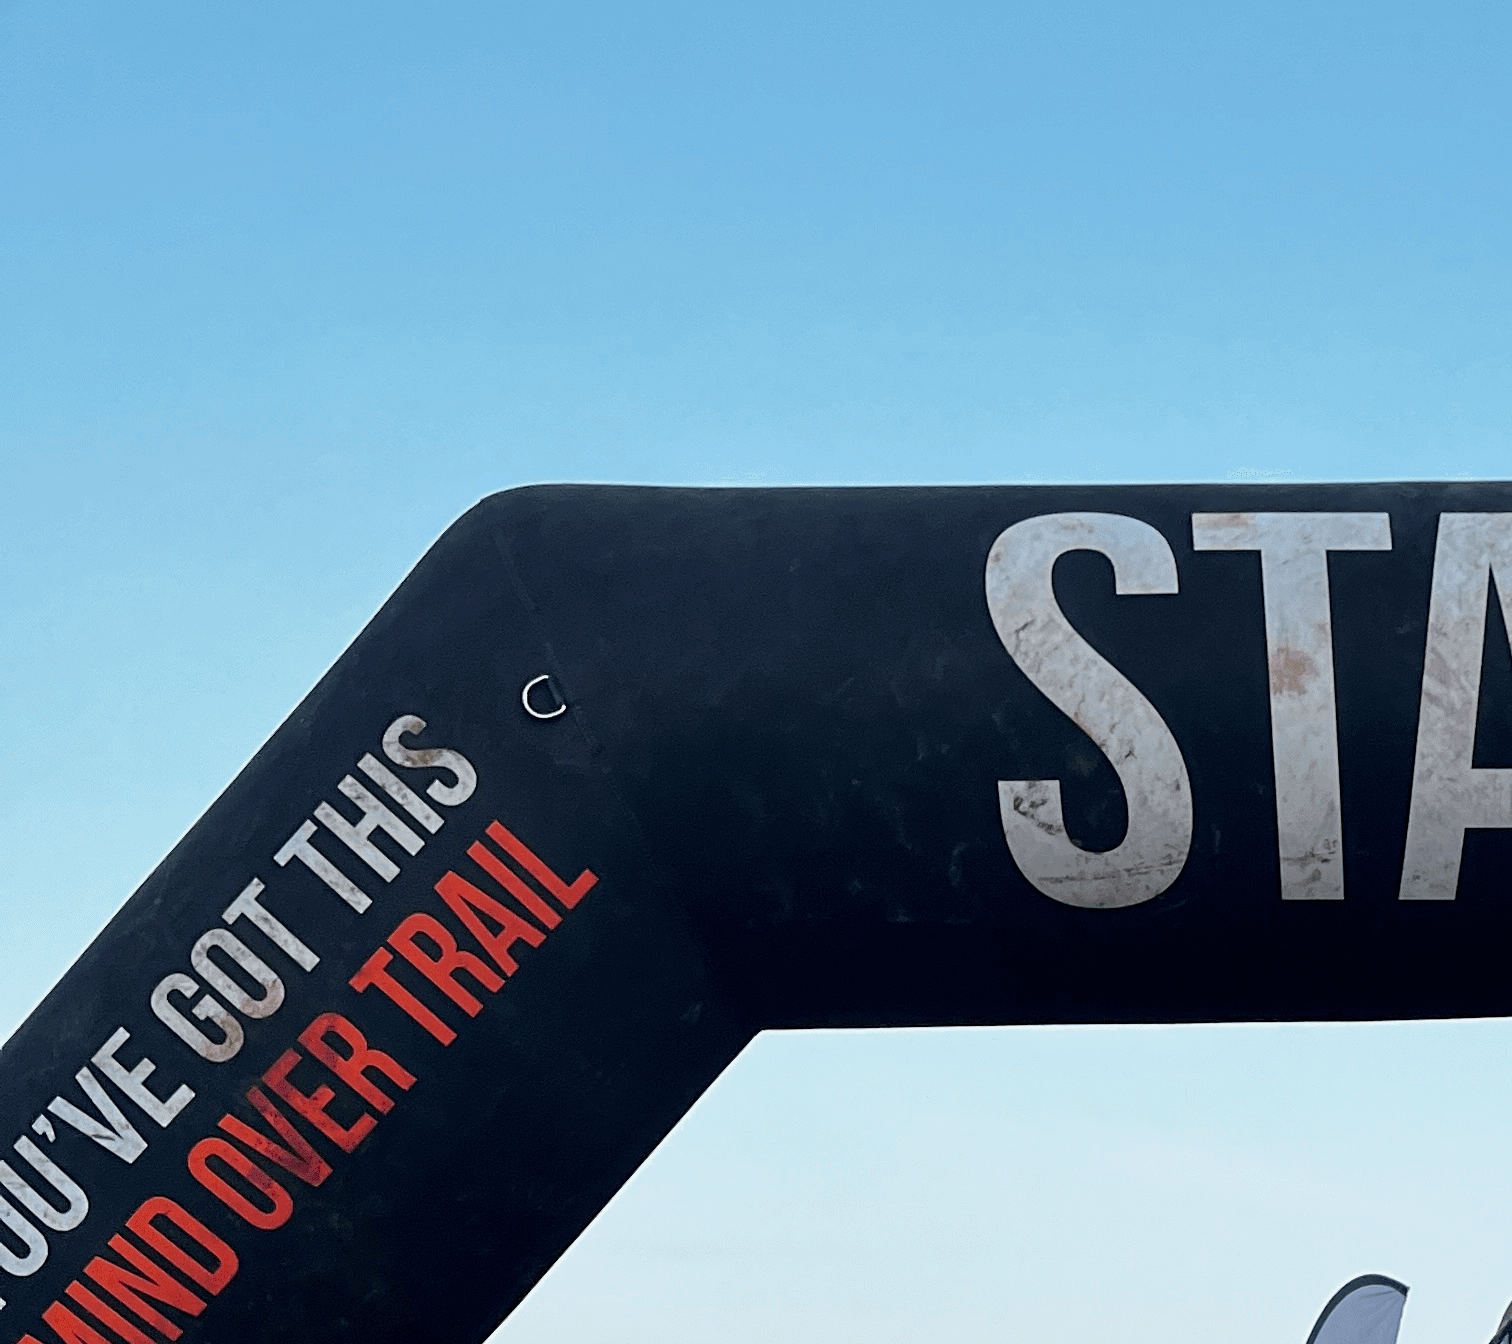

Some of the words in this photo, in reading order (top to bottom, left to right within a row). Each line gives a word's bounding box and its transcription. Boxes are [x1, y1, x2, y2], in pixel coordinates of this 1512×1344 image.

[0, 1026, 195, 1310] OU'VE
[151, 878, 319, 1063] GOT
[273, 714, 477, 914] THIS
[188, 1012, 417, 1229] OVER
[349, 820, 599, 1047] TRAIL
